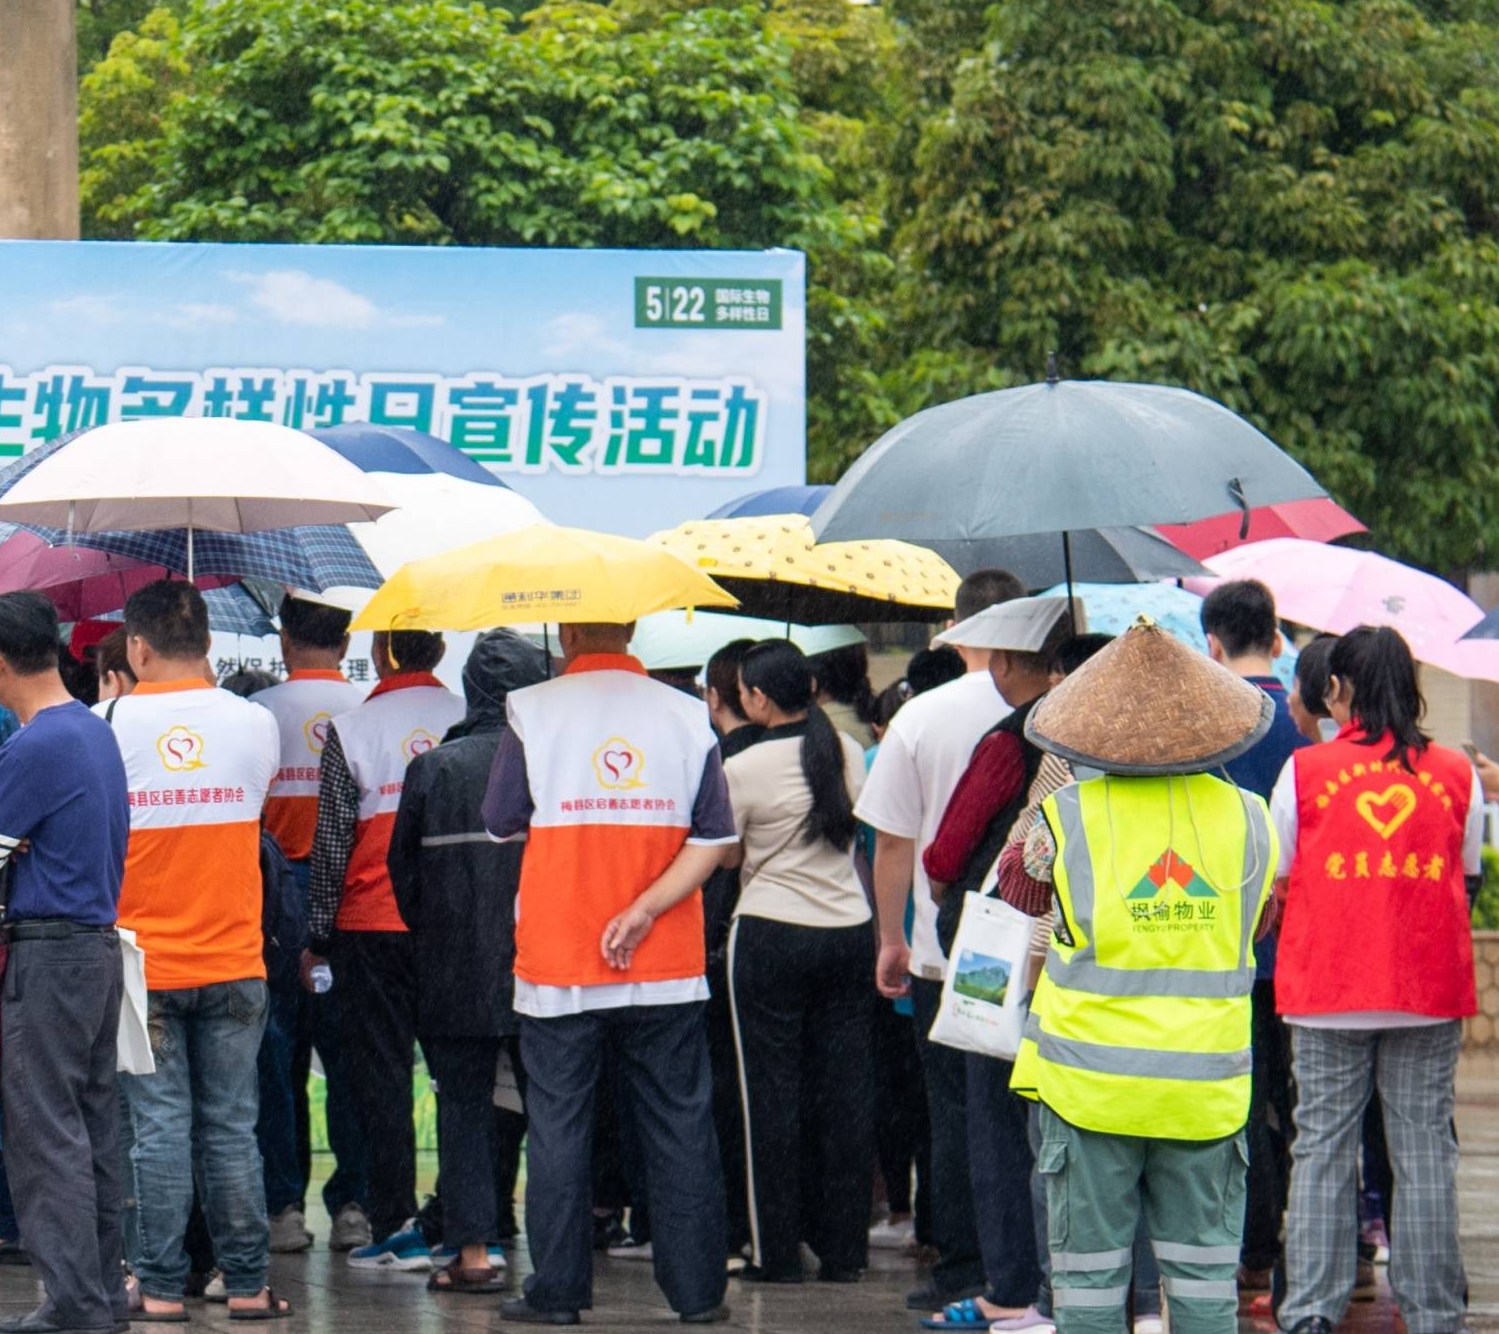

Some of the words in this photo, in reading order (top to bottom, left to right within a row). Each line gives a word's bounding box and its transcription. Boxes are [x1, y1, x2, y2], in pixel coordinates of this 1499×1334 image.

[715, 287, 771, 303] 国际生物
[715, 304, 770, 320] 多样性日
[560, 796, 677, 813] 梅县区启善志愿者协会
[1167, 923, 1216, 933] PROPERTY
